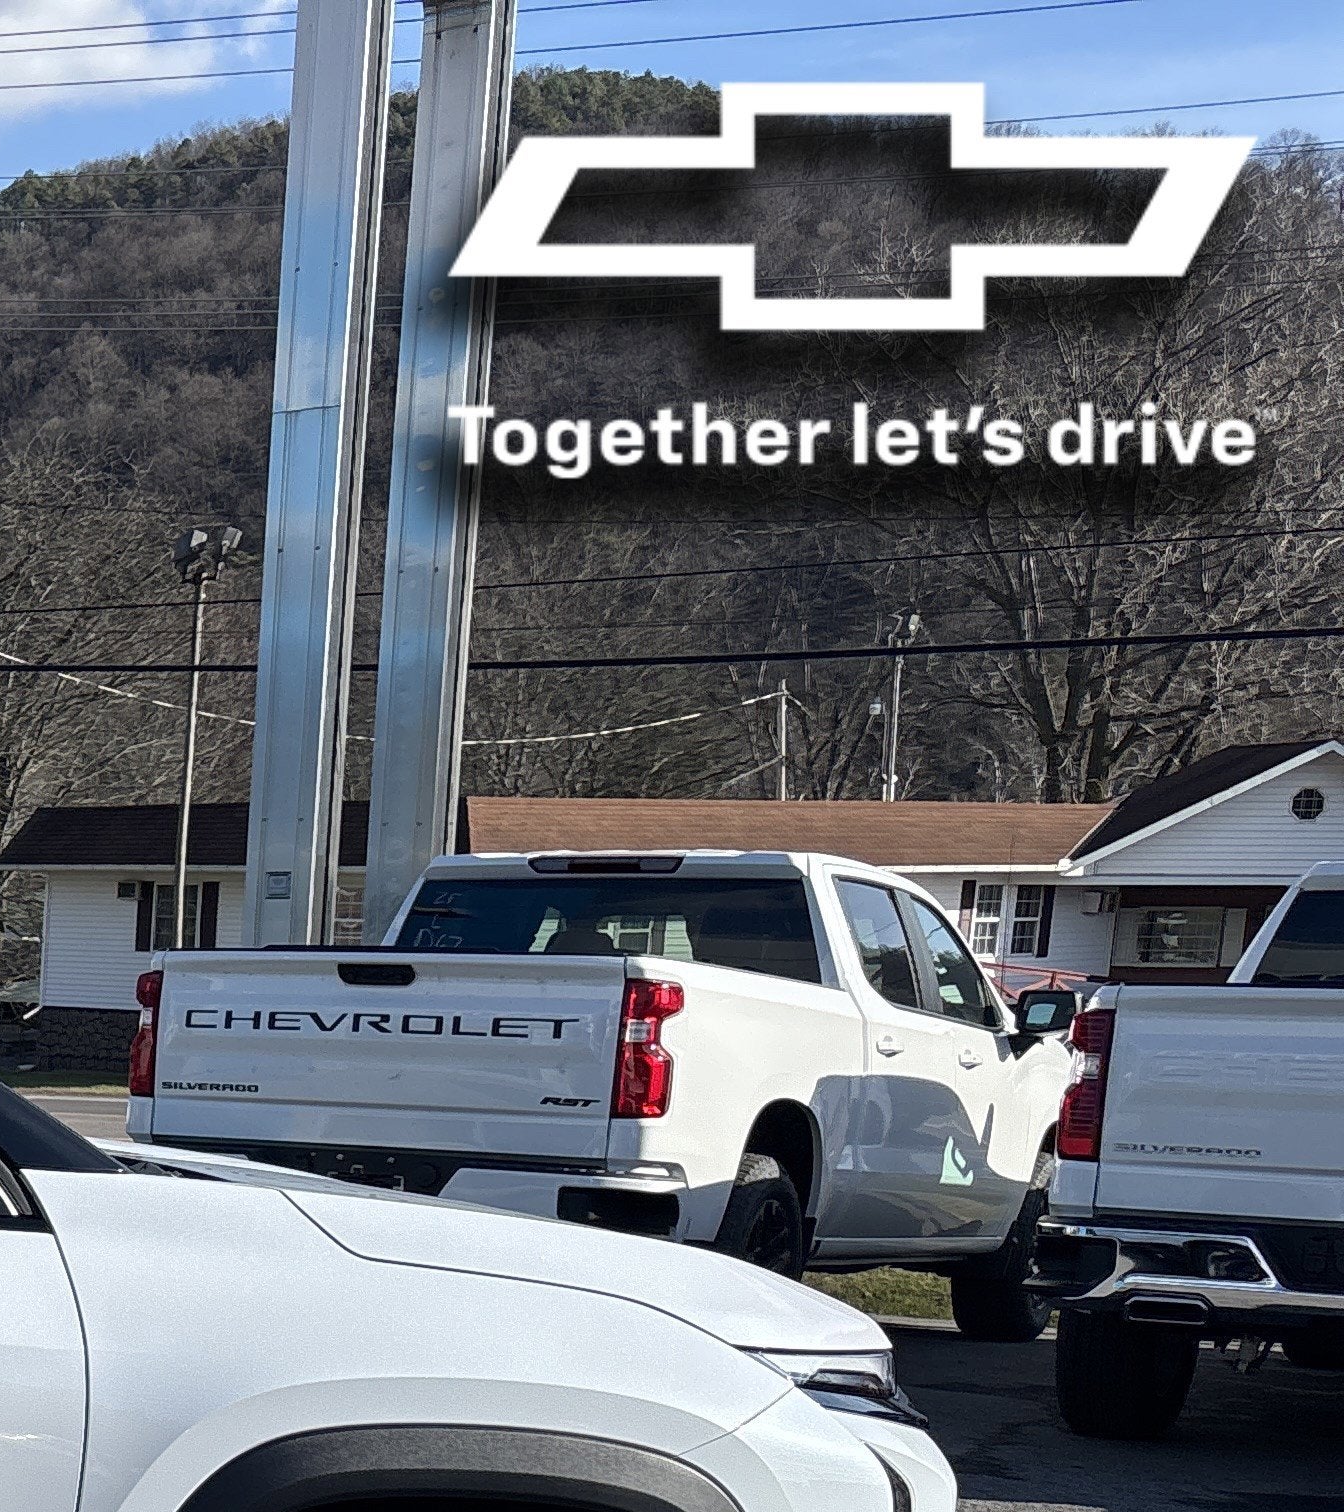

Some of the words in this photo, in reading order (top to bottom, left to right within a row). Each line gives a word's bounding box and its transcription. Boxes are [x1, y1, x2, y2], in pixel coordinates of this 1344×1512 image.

[184, 1009, 580, 1040] CHEVROLET
[161, 1081, 260, 1093] SILVERADO
[538, 1096, 602, 1108] RST
